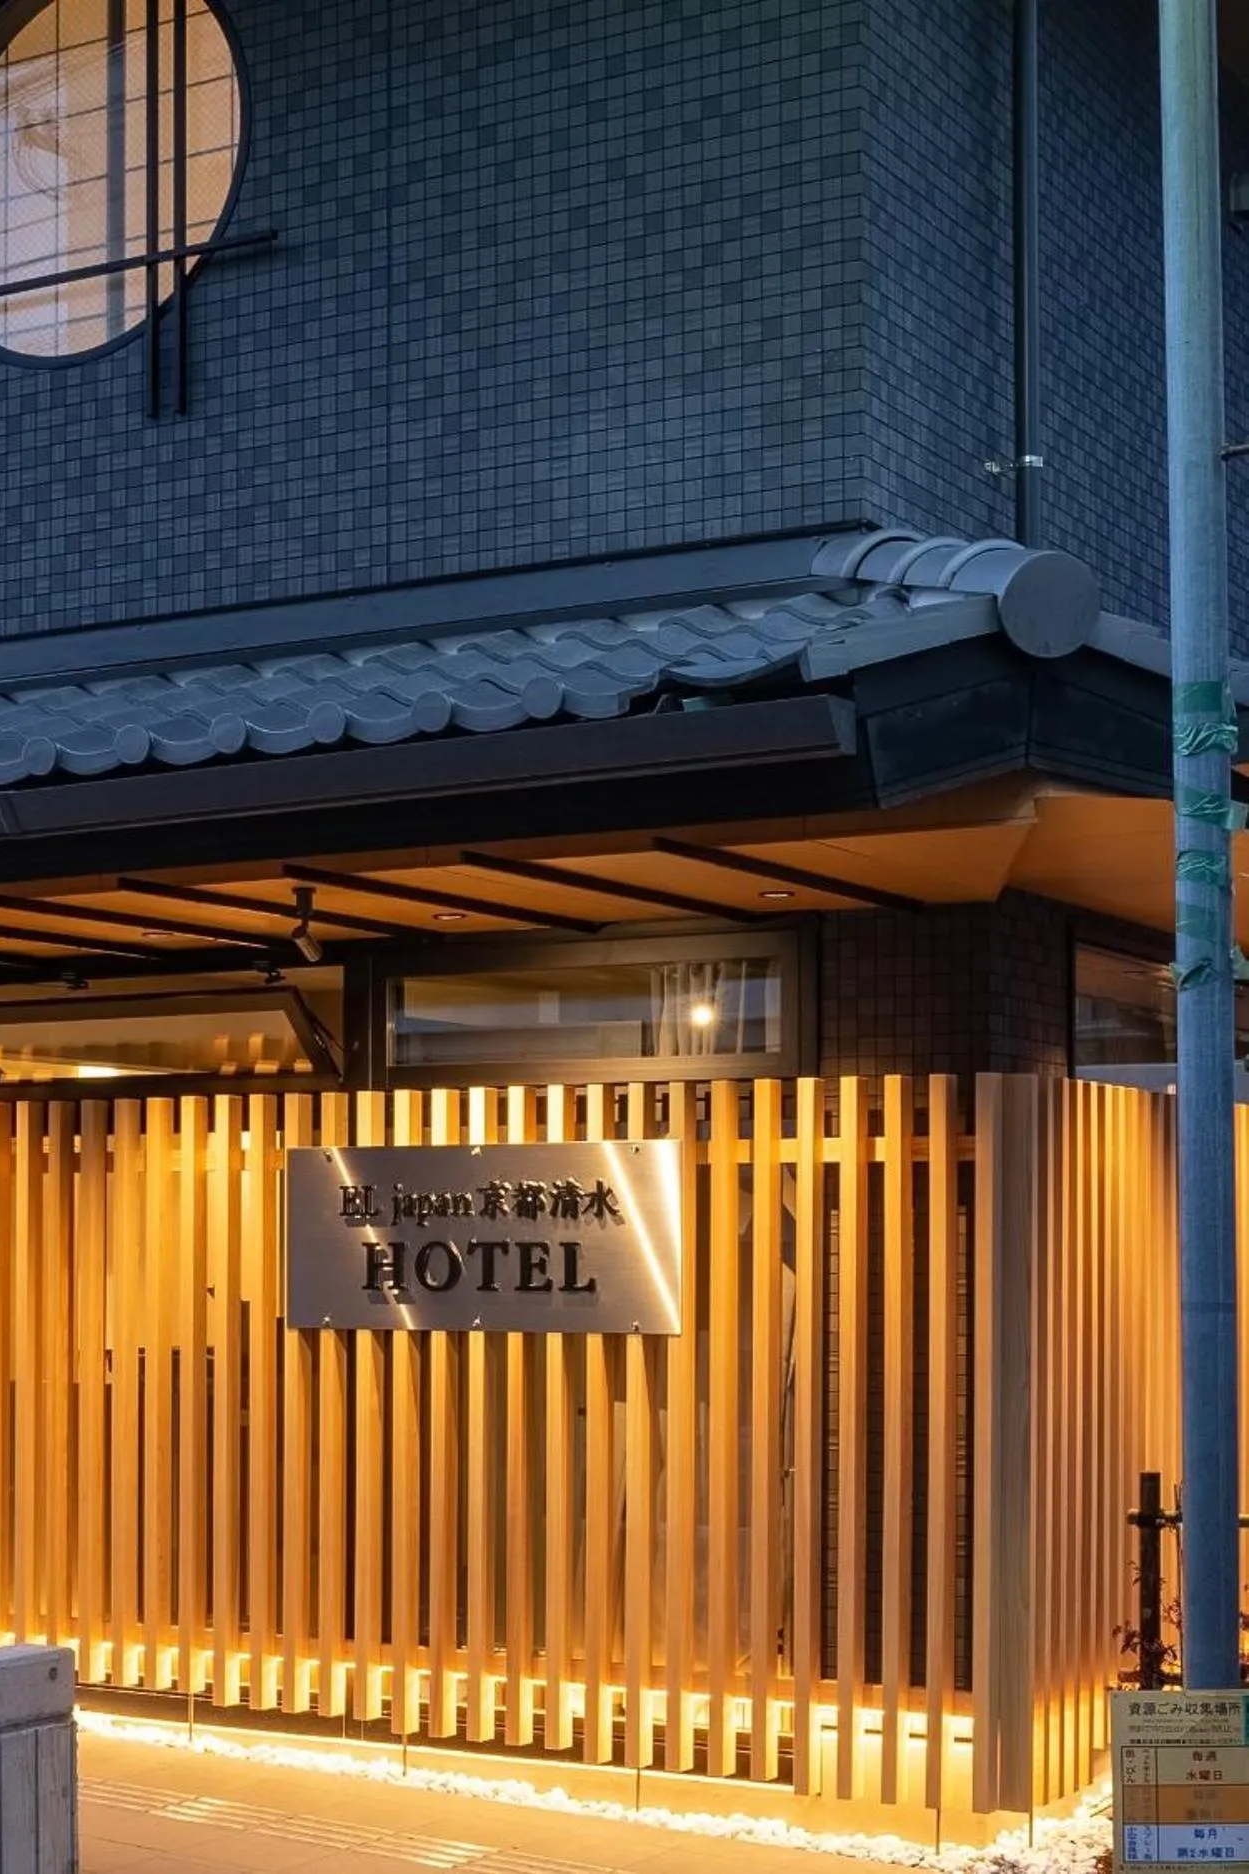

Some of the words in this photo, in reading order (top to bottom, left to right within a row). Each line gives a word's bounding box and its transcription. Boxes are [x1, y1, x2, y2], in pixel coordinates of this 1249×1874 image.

[339, 1185, 379, 1217] EL
[390, 1182, 476, 1227] japan
[477, 1177, 622, 1220] 京都清水
[361, 1240, 597, 1292] HOTEL
[1185, 1769, 1223, 1781] 水曜日
